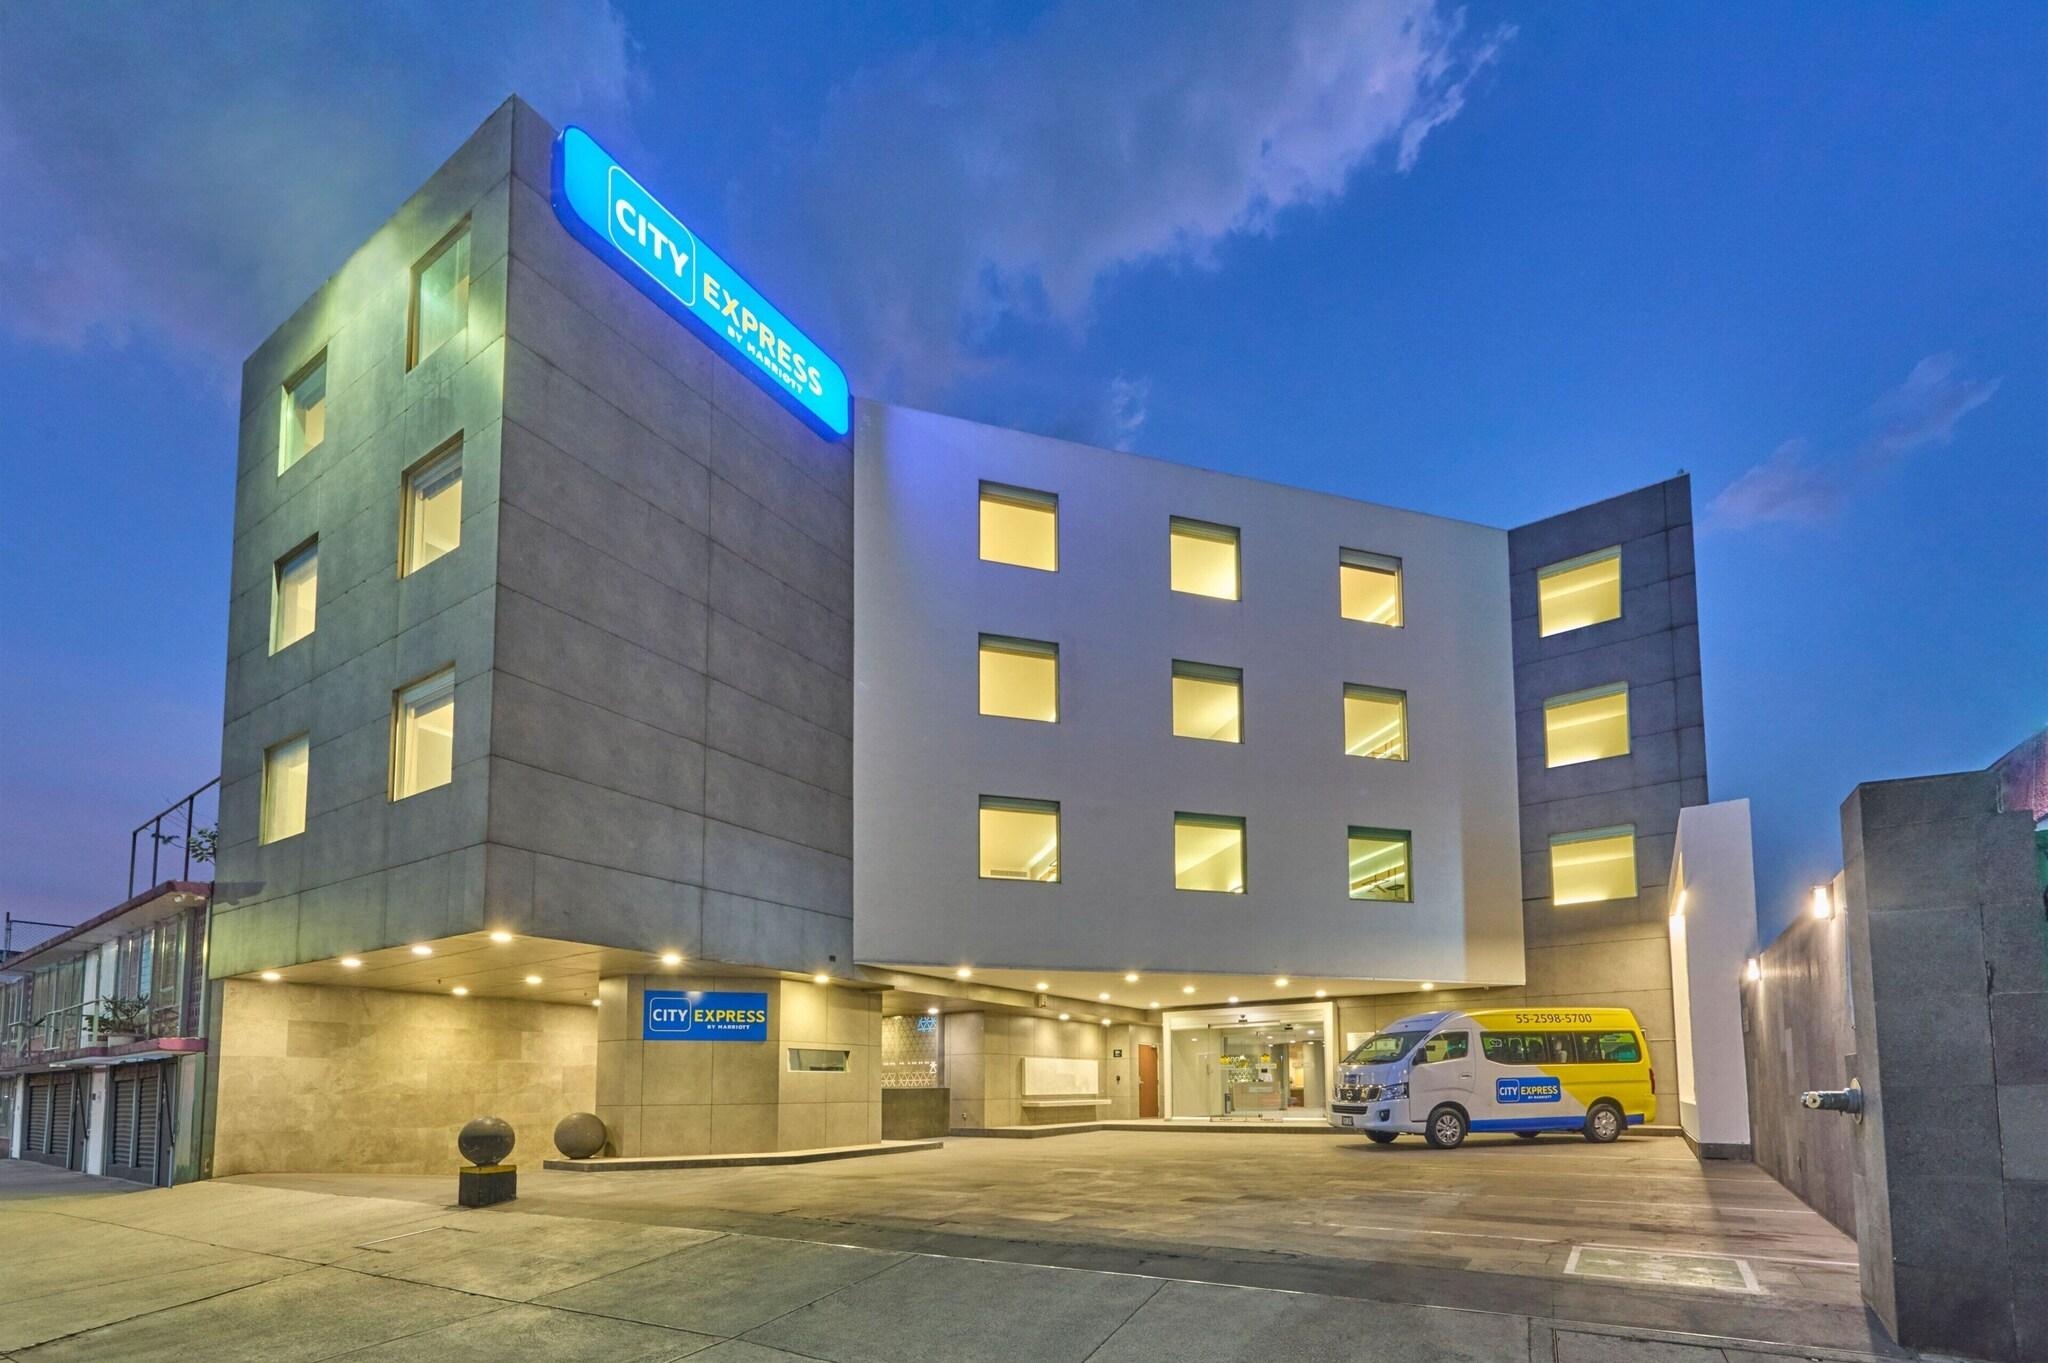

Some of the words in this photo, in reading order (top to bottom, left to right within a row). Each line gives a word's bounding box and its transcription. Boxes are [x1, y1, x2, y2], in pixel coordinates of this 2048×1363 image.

[615, 199, 689, 277] CITY
[703, 272, 822, 396] EXPRESS
[727, 325, 743, 344] BY
[747, 341, 803, 394] MARRIOTT
[653, 1009, 688, 1022] CITY
[694, 1009, 766, 1023] EXPRESS
[1515, 1013, 1592, 1024] 55-2598-5700
[1500, 1086, 1518, 1096] CITY
[1520, 1085, 1558, 1095] EXPRESS
